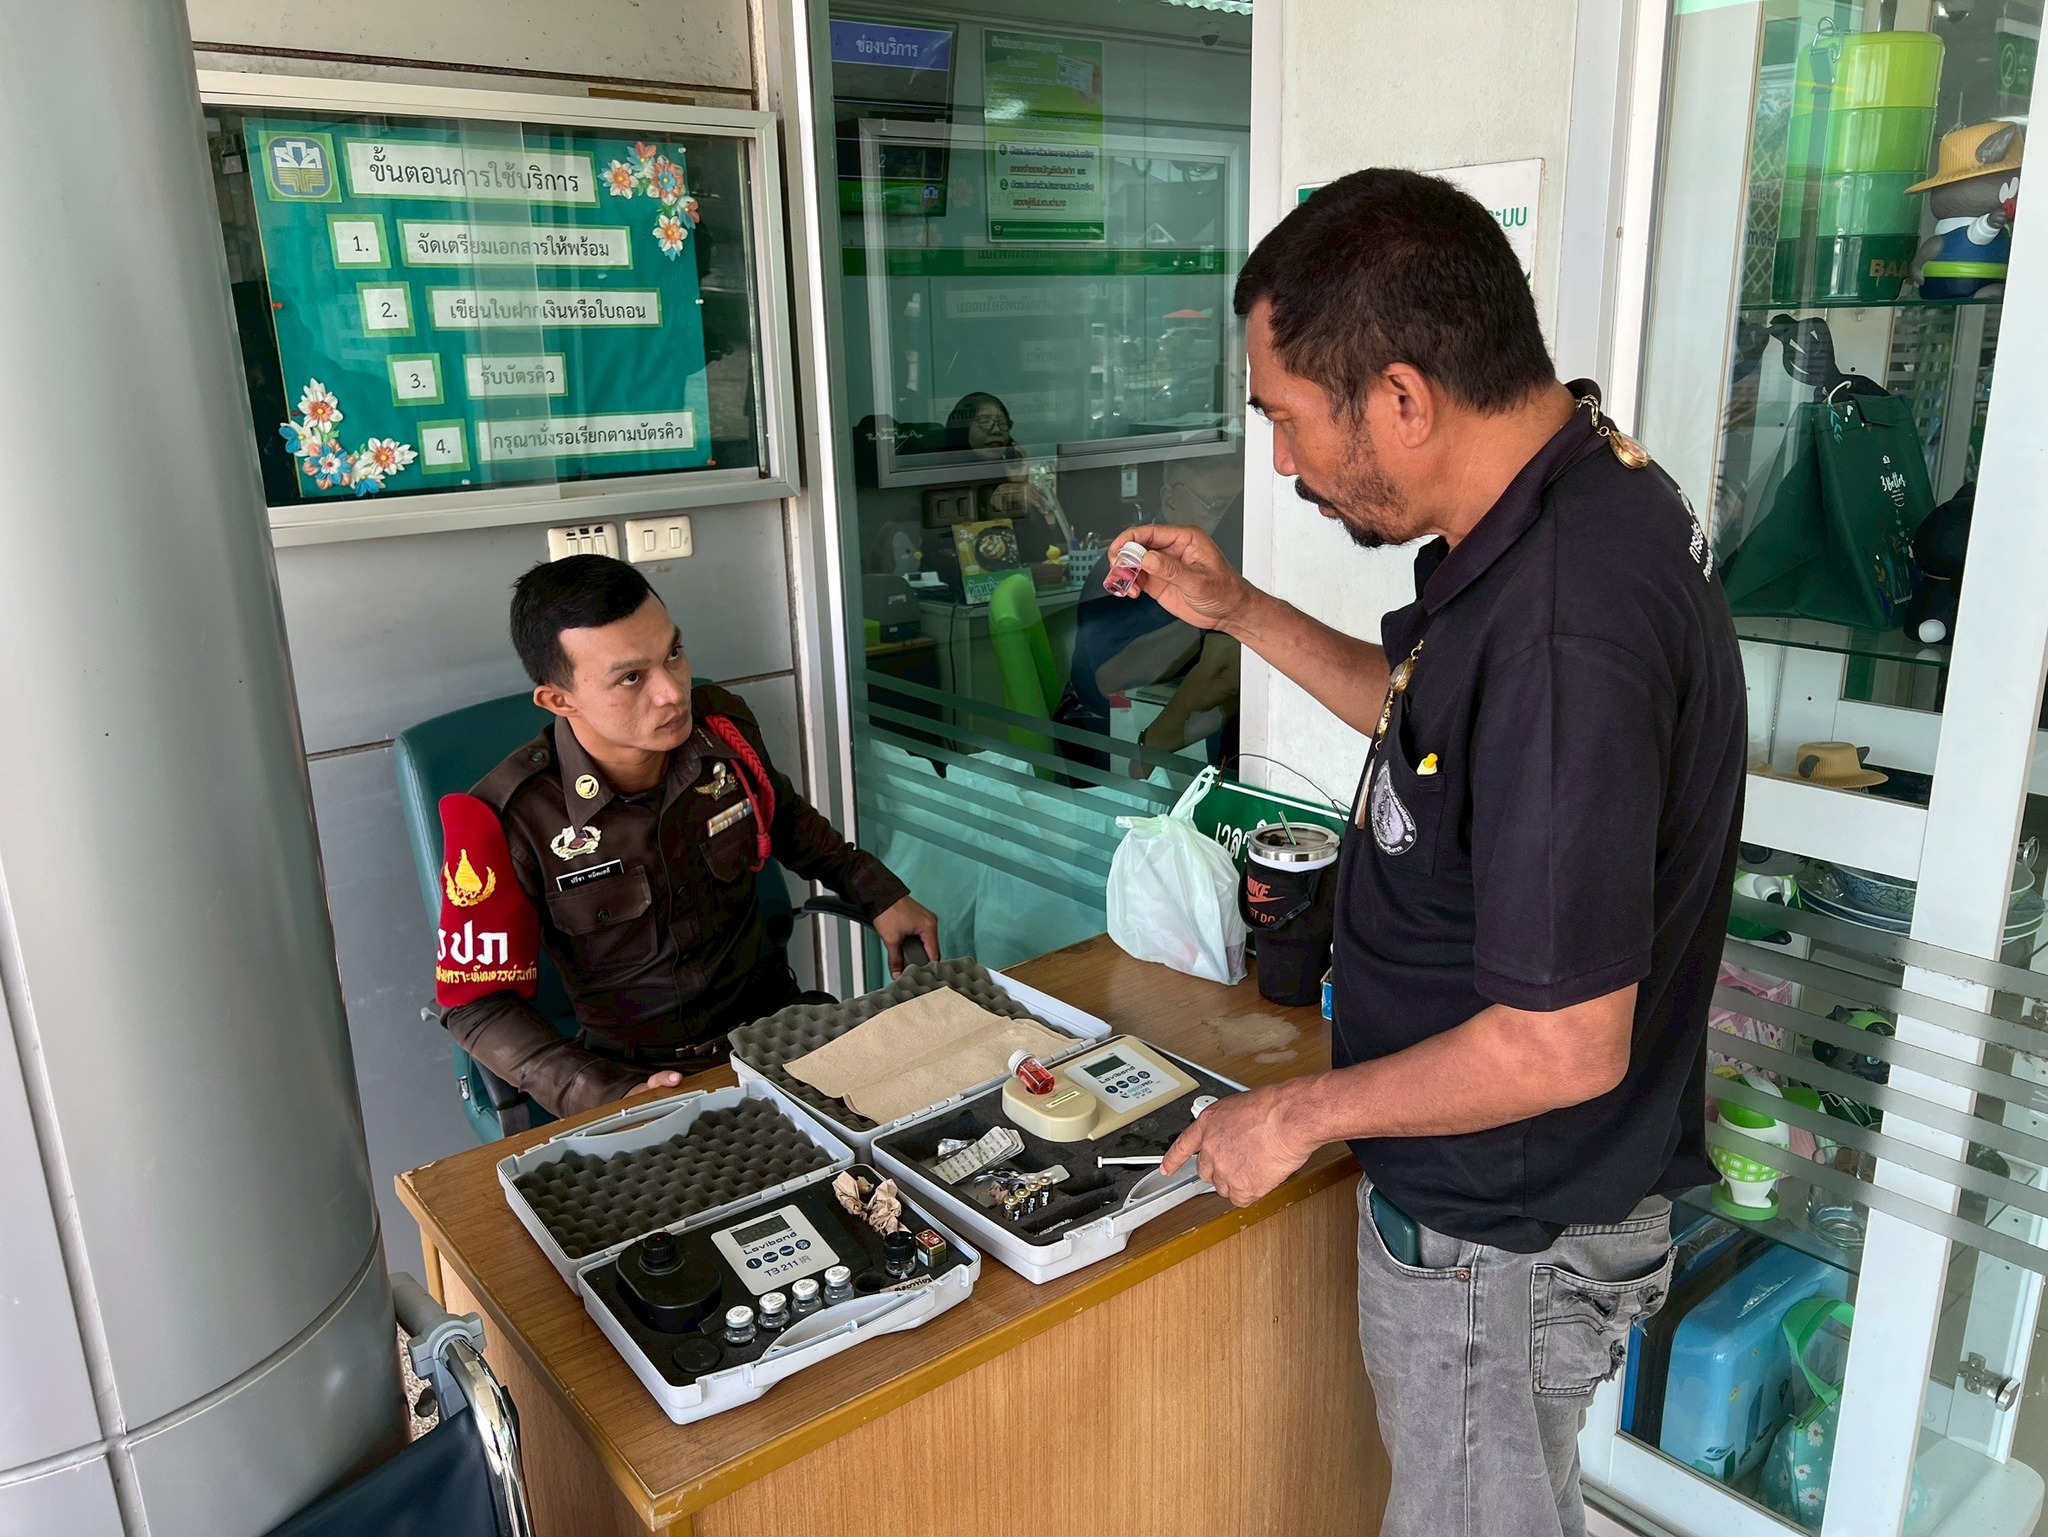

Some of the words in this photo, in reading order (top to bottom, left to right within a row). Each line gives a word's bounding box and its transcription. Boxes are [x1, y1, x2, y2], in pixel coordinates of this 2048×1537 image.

[856, 34, 919, 57] ช่องบริการ
[370, 146, 579, 193] ขั้นตอนการใช้บริการ
[352, 235, 370, 252] 1.
[417, 232, 610, 257] จัดเตรียมเอกสารให้พร้อม
[1869, 259, 1912, 277] BAA
[381, 301, 398, 319] 2.
[450, 298, 647, 320] เขียนใบฝากเงินหรือใบถอน
[410, 373, 427, 389] 3.
[481, 365, 556, 385] รับบัตรคิว
[435, 438, 451, 454] 4.
[493, 422, 684, 454] กรุณานั่งรอเรียกตามบัตรคิว
[437, 919, 509, 966] รปภ
[1098, 1065, 1136, 1084] Lovibond
[743, 1231, 797, 1255] Lovibond
[764, 1267, 780, 1277] TB
[780, 1260, 799, 1271] 211
[799, 1255, 812, 1264] IR
